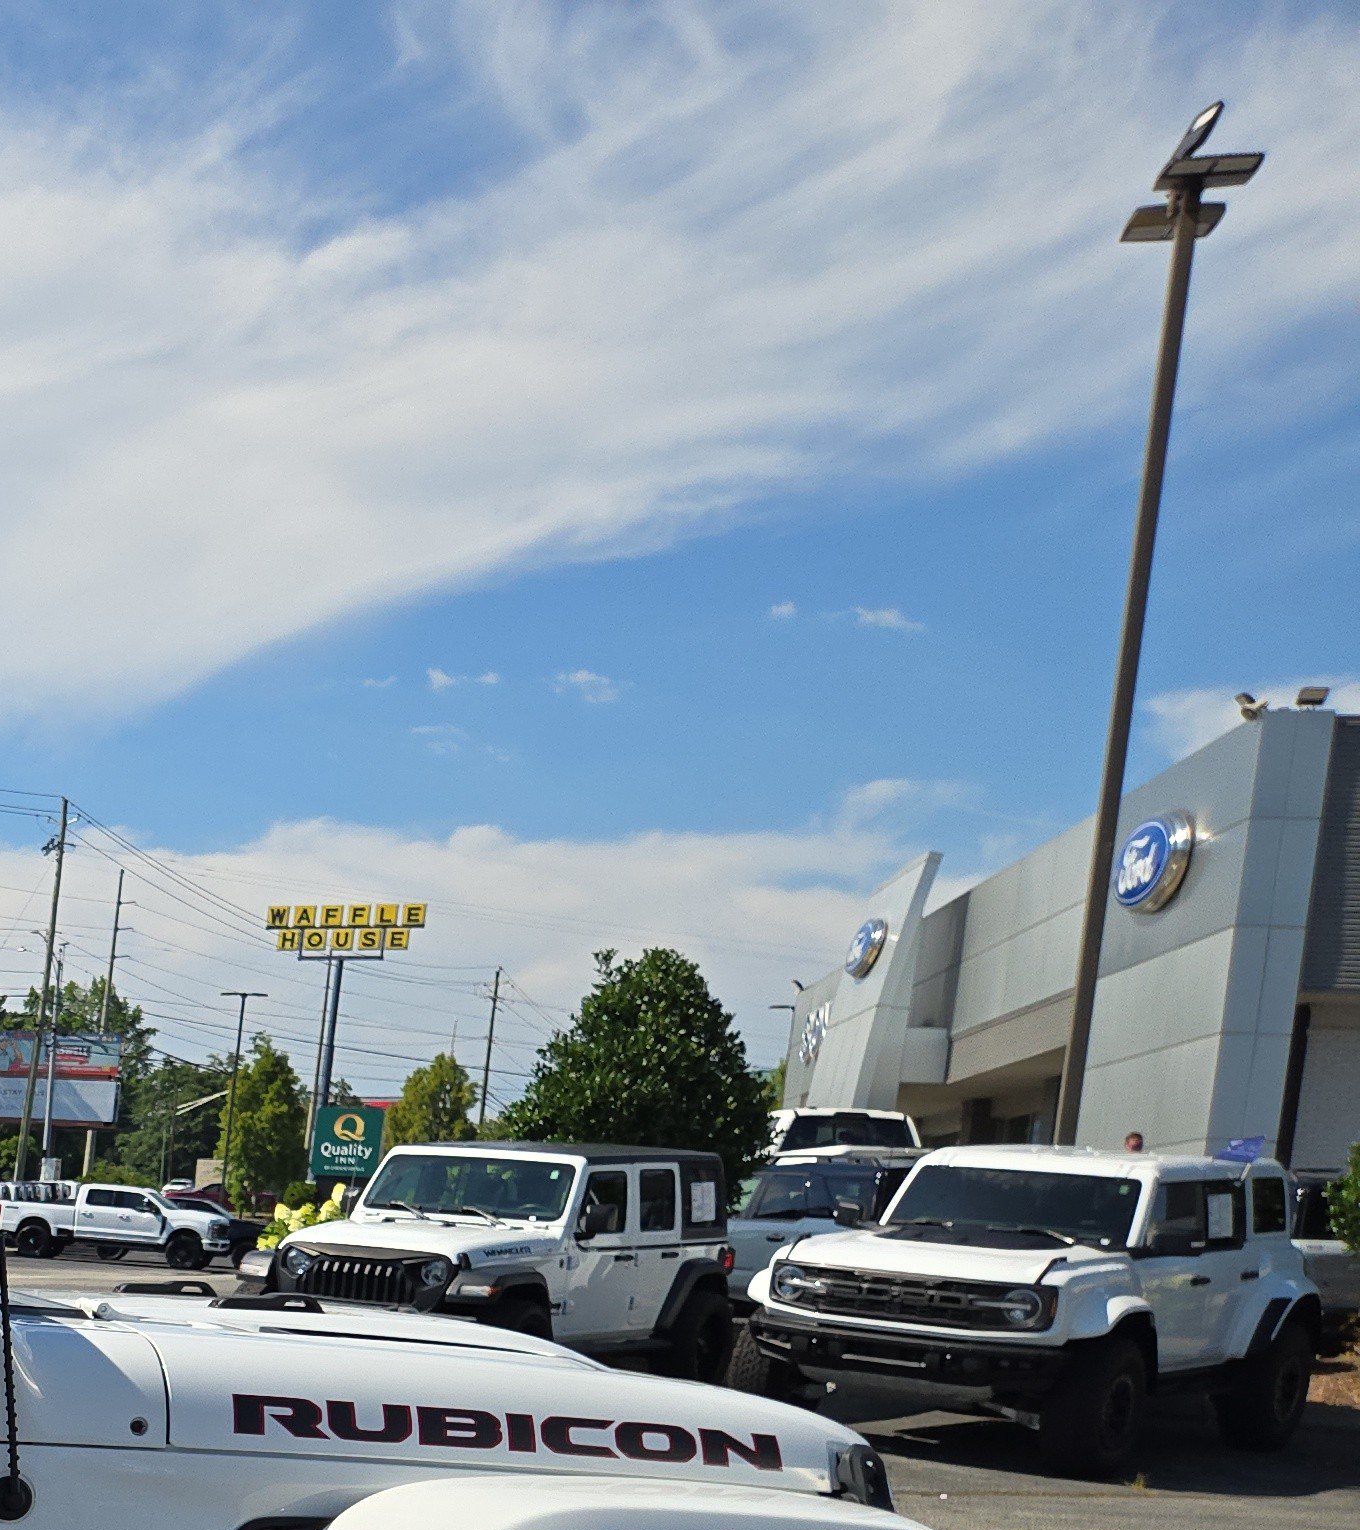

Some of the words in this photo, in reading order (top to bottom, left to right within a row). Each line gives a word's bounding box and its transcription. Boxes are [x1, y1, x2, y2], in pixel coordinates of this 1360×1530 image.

[1118, 835, 1159, 895] Ford
[270, 906, 421, 924] WAFFLE
[282, 931, 405, 948] HOUSE
[321, 1141, 373, 1160] Quality
[335, 1156, 356, 1165] INN
[232, 1393, 784, 1471] RUBICON
